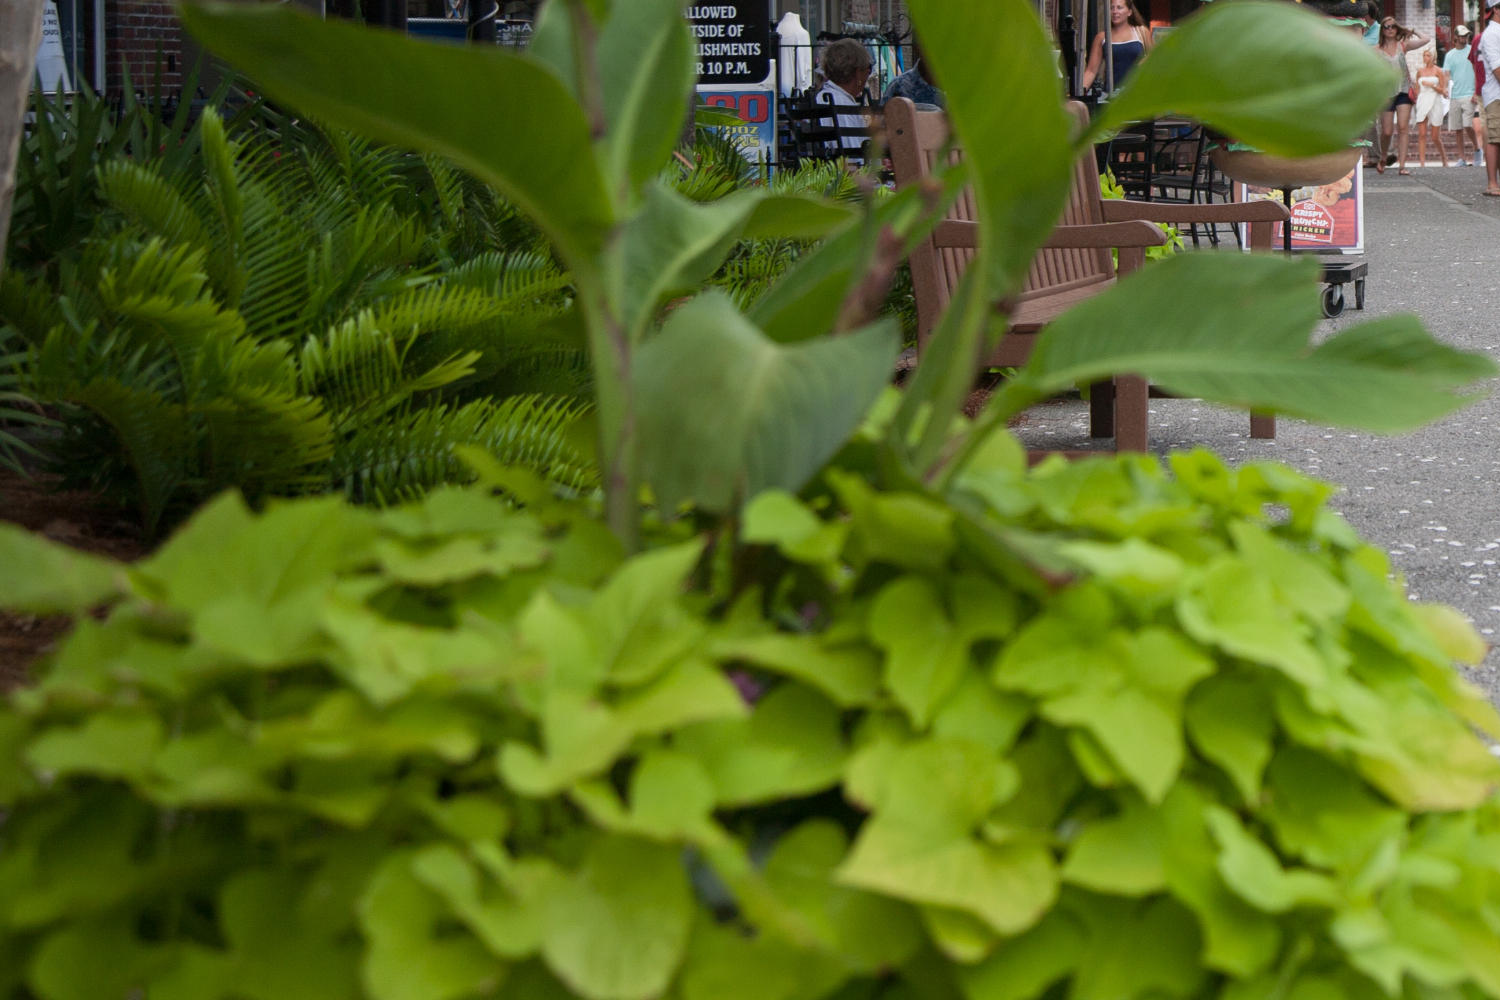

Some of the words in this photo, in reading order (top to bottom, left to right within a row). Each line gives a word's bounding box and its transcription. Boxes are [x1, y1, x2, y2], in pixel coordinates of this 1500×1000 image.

[690, 24, 726, 37] TSIDE
[728, 24, 745, 37] OF
[695, 42, 762, 56] LISHMENTS
[708, 62, 722, 75] 10
[725, 62, 751, 75] P.M.
[1294, 209, 1324, 218] KRISPY
[1291, 216, 1328, 227] RUNCHY
[1293, 225, 1325, 234] HICKEN
